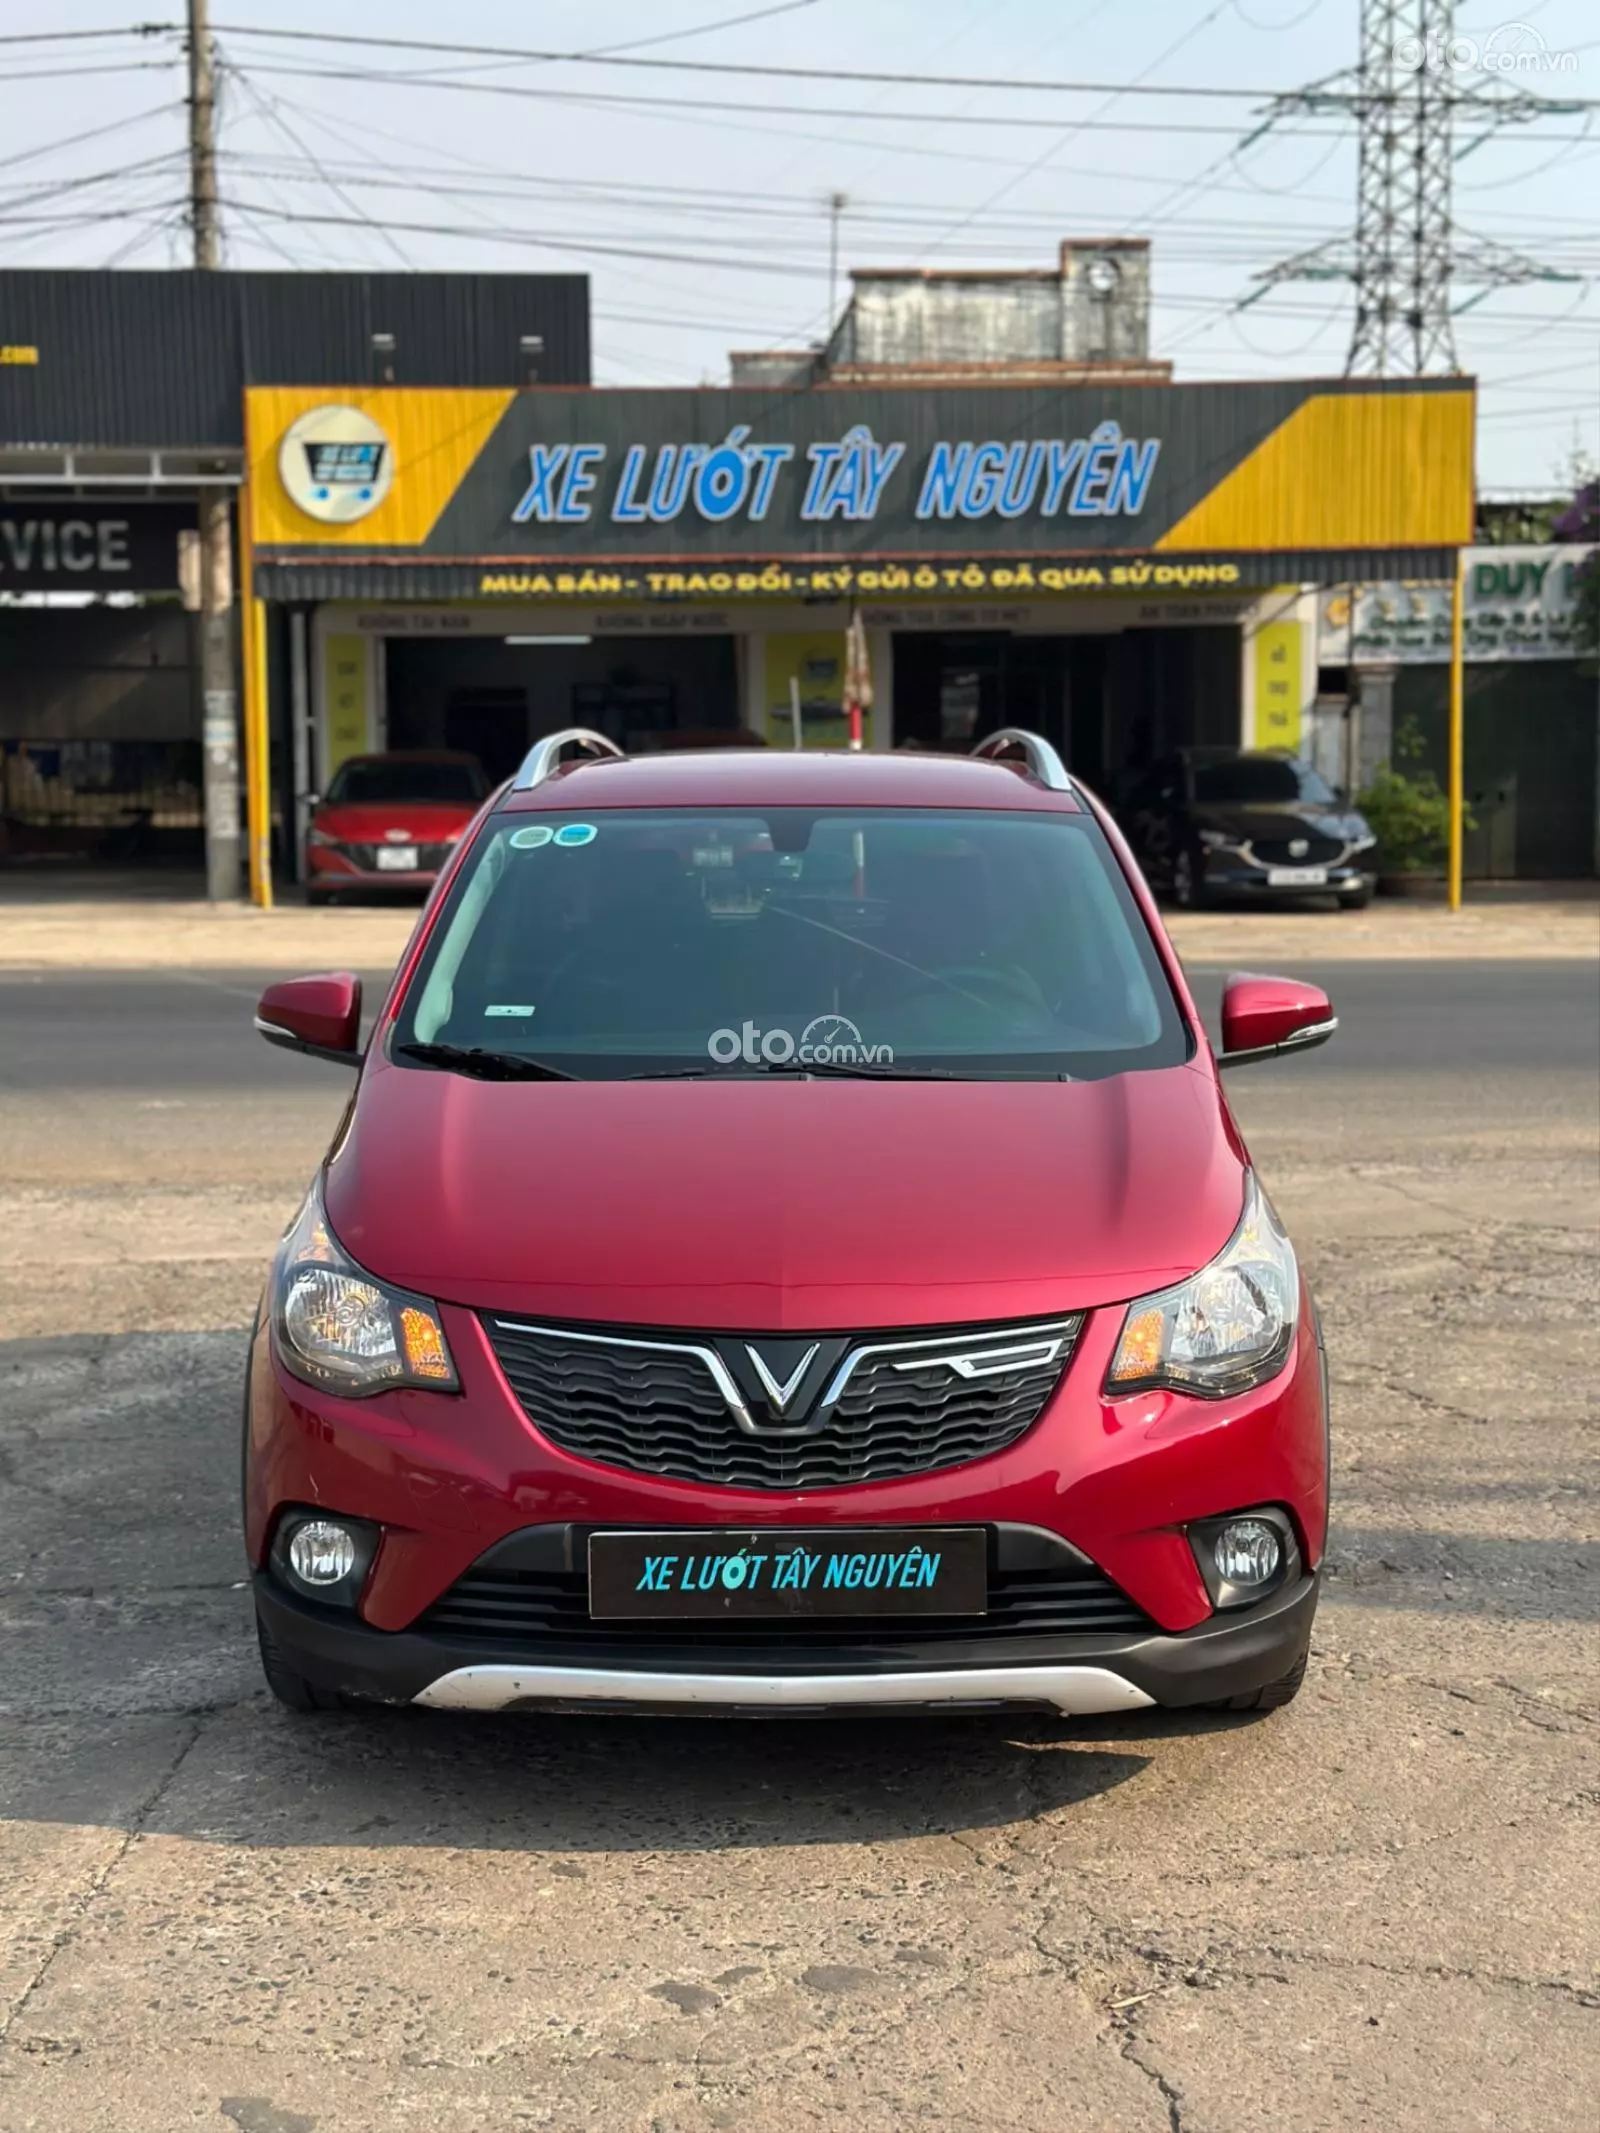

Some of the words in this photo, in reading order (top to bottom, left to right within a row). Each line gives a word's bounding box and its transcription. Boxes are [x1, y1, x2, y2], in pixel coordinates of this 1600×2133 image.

[511, 444, 606, 522] XE
[610, 424, 795, 523] LƯỚT
[800, 424, 906, 520] TÂY
[915, 419, 1161, 519] NGUYÊN
[0, 519, 131, 571] VICE
[481, 573, 551, 592] MUA
[556, 568, 622, 593] BÁN
[645, 573, 733, 591] TRAO
[735, 562, 791, 591] ĐỔI
[810, 566, 851, 590] KÝ
[857, 563, 909, 590] GỬI
[913, 565, 937, 588] Ô
[942, 564, 985, 588] TÔ
[990, 563, 1034, 588] ĐÃ
[1038, 567, 1103, 590] QUA
[1109, 558, 1152, 586] SỬ
[1153, 564, 1239, 588] DỤNG
[1477, 561, 1550, 596] DUY
[636, 1556, 678, 1590] XE
[680, 1547, 767, 1590] LƯỚT
[771, 1548, 821, 1589] TÂY
[822, 1546, 941, 1588] NGUYÊN
